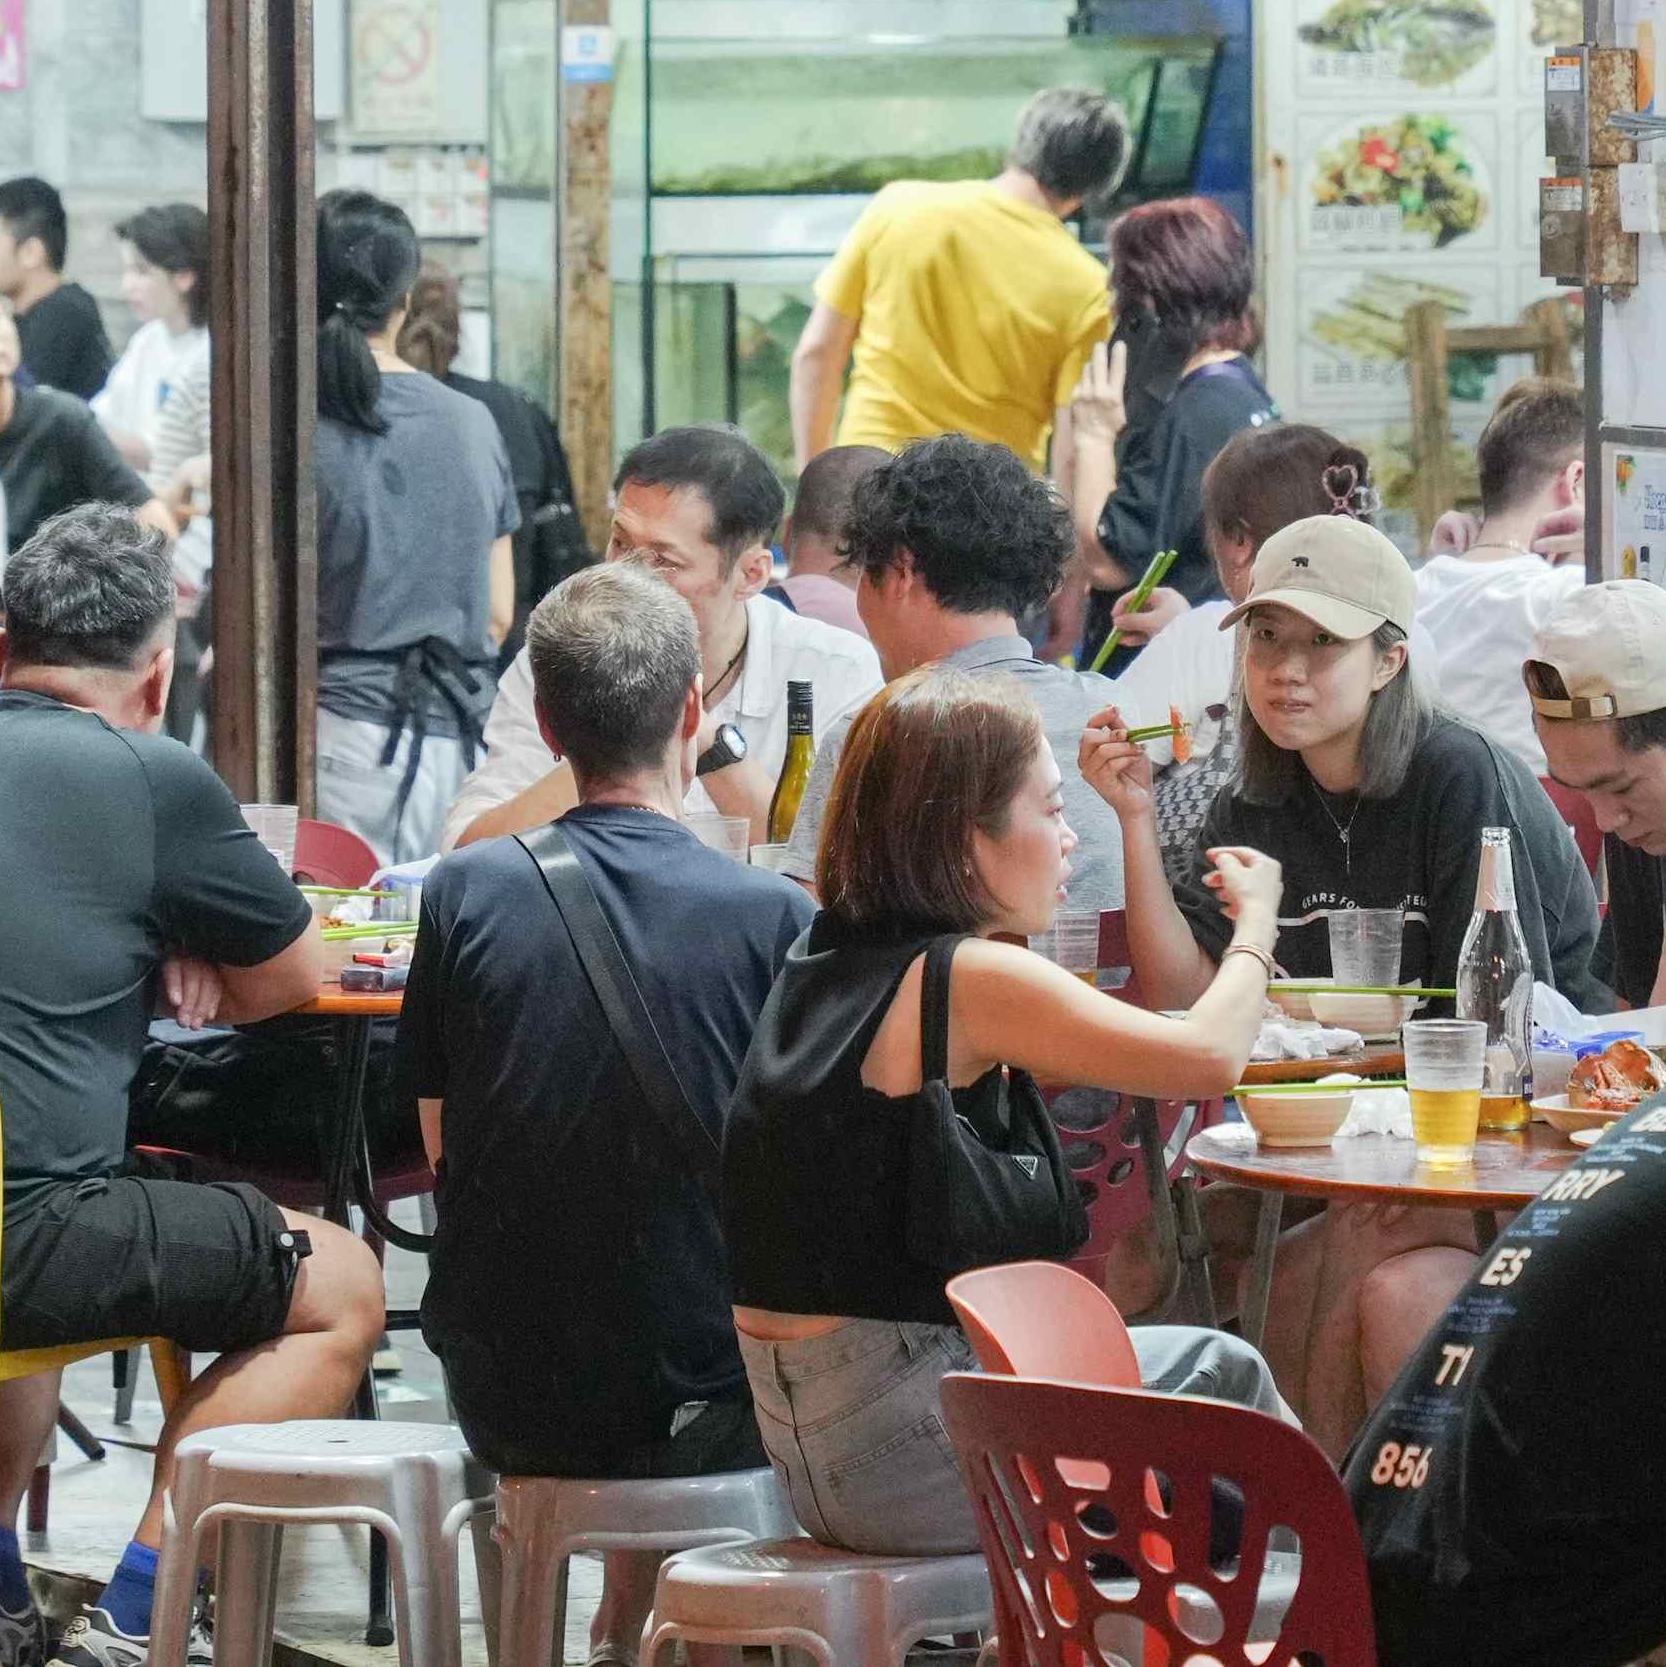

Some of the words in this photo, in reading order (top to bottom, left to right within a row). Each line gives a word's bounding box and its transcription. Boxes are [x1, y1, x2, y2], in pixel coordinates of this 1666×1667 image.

[1302, 892, 1336, 909] GEARS
[1542, 1169, 1626, 1201] RRY
[1480, 1247, 1532, 1287] ES
[1371, 1441, 1433, 1490] 856
